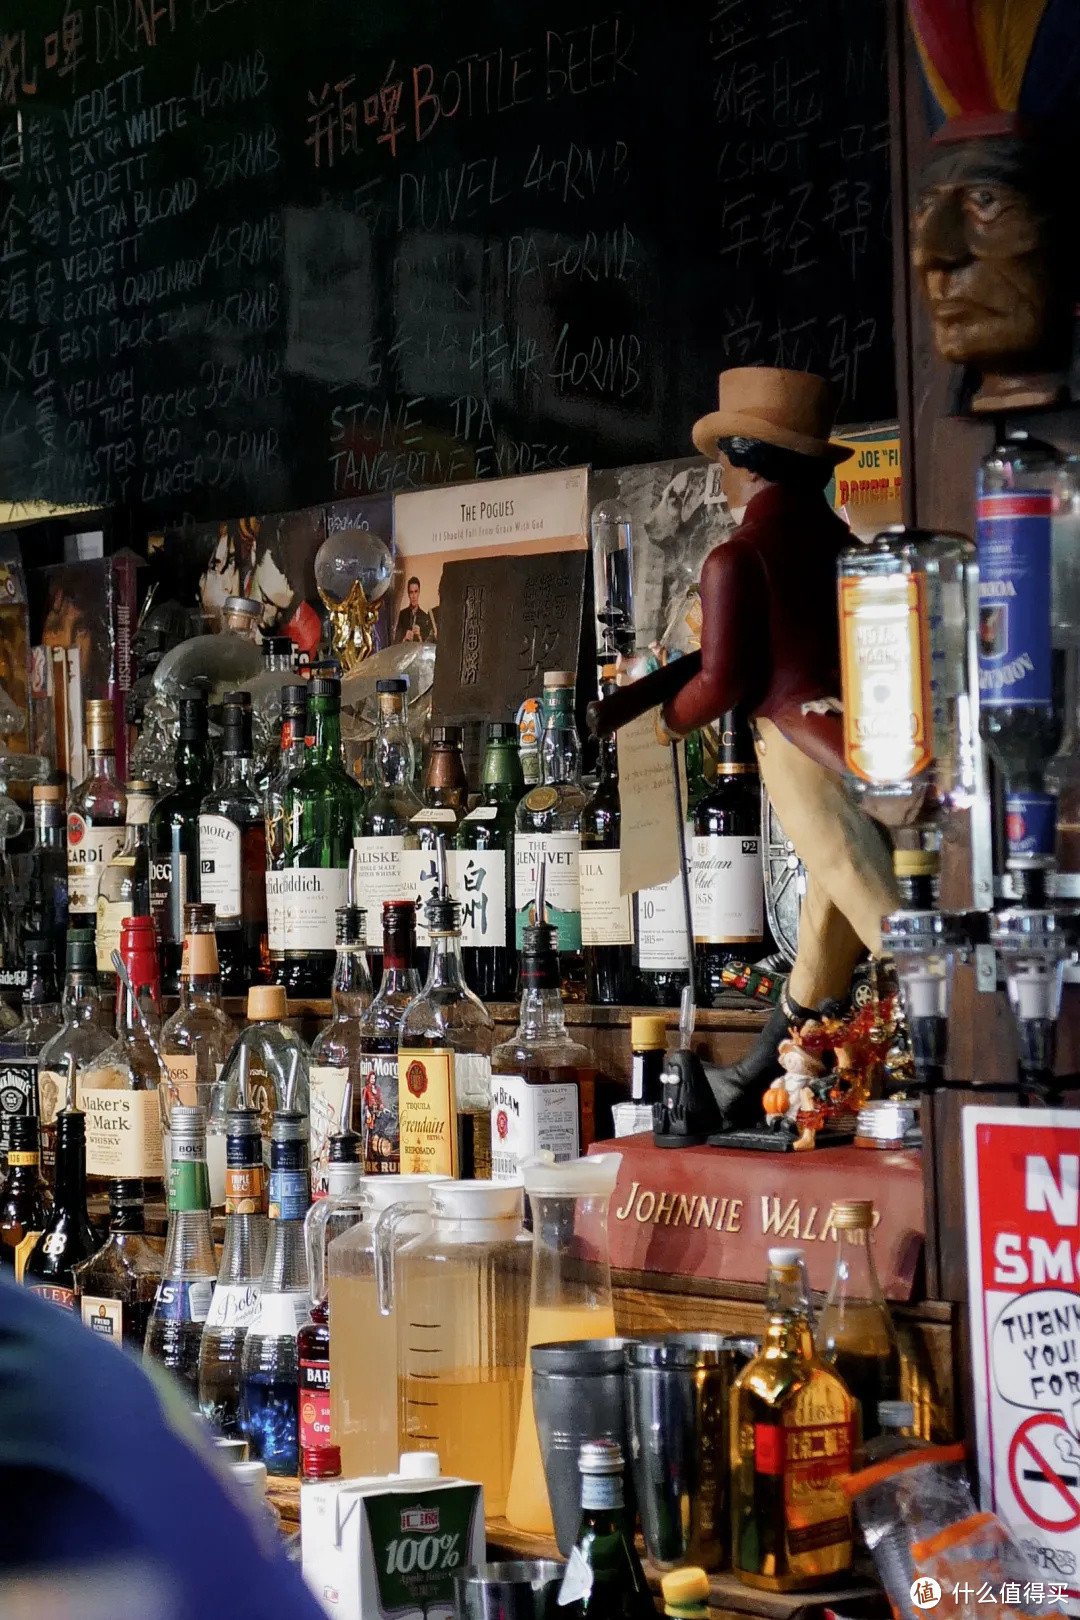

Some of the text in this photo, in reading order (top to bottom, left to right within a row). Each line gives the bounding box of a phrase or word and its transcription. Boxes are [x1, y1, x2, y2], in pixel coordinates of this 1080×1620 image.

[413, 47, 533, 142] BOTTLE
[545, 11, 638, 101] BEER
[64, 65, 145, 139] VEDETT
[126, 97, 188, 148] WHITE
[66, 152, 148, 215] VEDETT
[68, 198, 128, 246] EXTRA
[134, 177, 198, 228] BLOND
[61, 231, 144, 283] VEDETT
[63, 283, 117, 322] EXTRA
[60, 322, 104, 364] EASY
[548, 322, 642, 399] 40RMB
[65, 416, 93, 446] ON
[99, 397, 136, 438] THE
[141, 386, 197, 427] ROCKS
[329, 395, 498, 448] STONE IPA
[858, 450, 880, 468] JOE
[443, 529, 464, 541] Should
[466, 527, 477, 539] Fall
[478, 526, 494, 538] From
[495, 523, 514, 536] Grace
[515, 522, 530, 533] With
[532, 519, 544, 531] God
[529, 841, 547, 851] THE
[743, 841, 757, 852] 92
[202, 861, 212, 873] 12
[644, 900, 654, 919] 10
[82, 1096, 130, 1112] Maker's
[93, 1115, 131, 1131] Mark
[406, 1102, 431, 1110] TEQUILA
[89, 1137, 122, 1145] WHISKY
[405, 1146, 436, 1155] REPOSADO
[616, 1182, 743, 1233] JOHNNIE
[994, 1232, 1080, 1285] SM
[1024, 1339, 1077, 1370] YOU!
[386, 1533, 460, 1575] 100%
